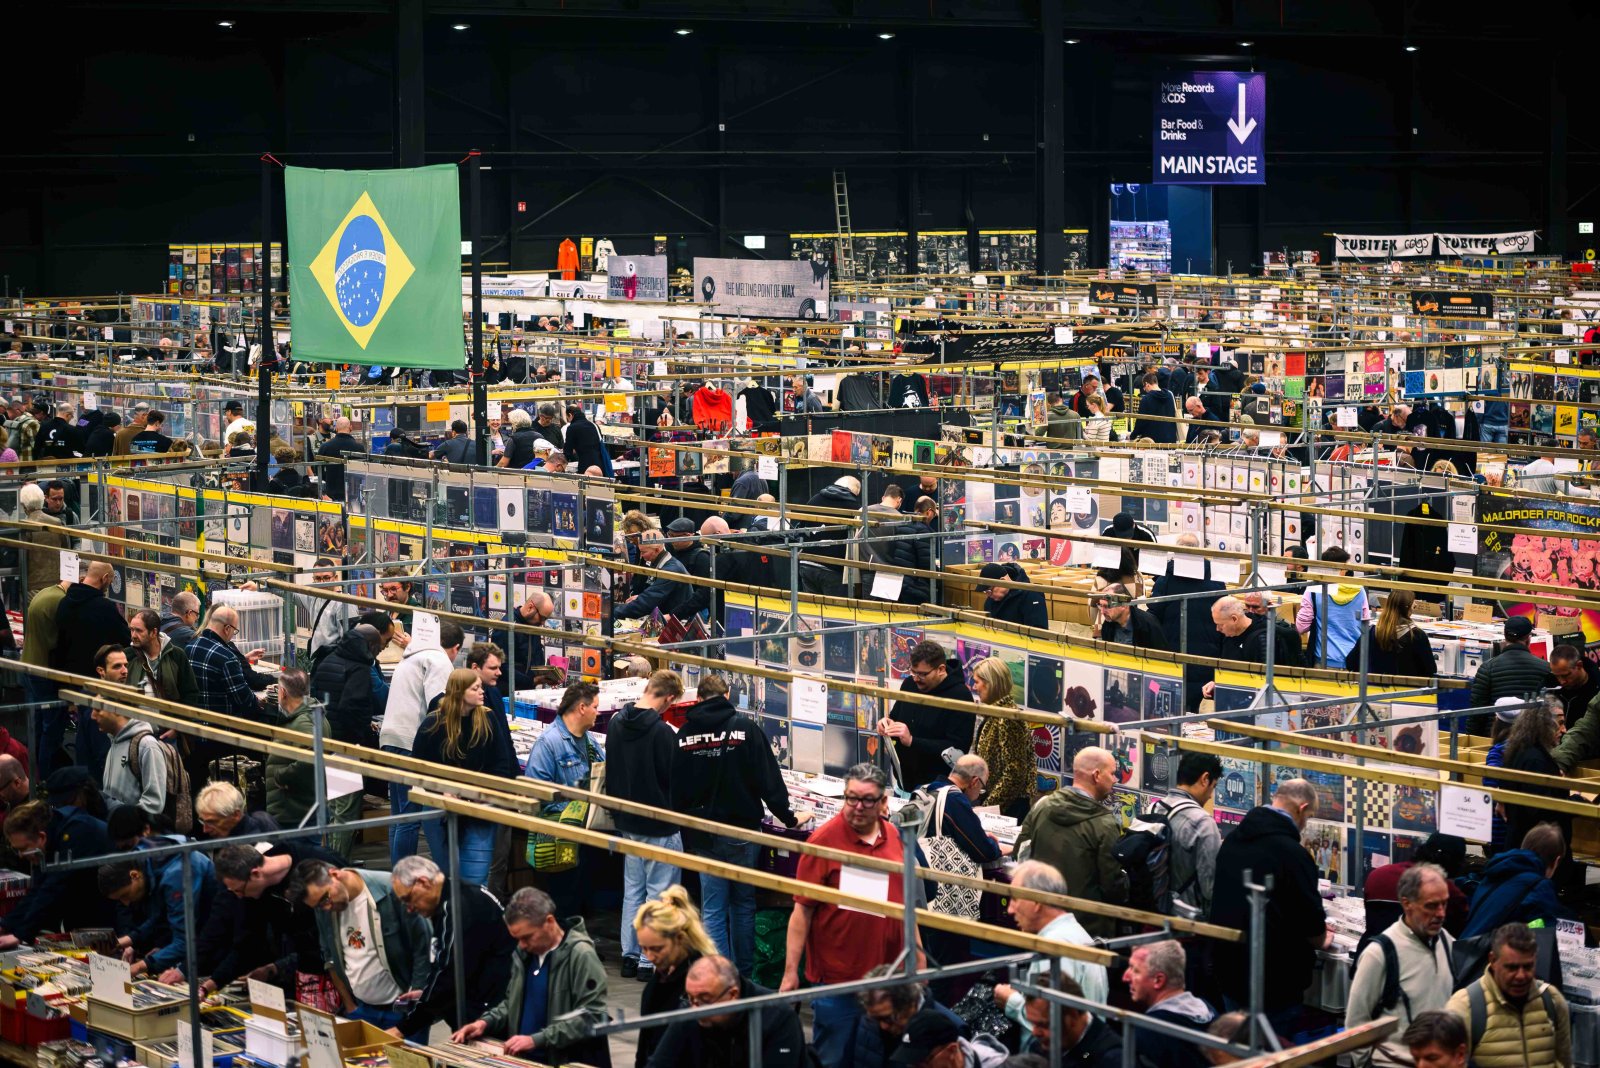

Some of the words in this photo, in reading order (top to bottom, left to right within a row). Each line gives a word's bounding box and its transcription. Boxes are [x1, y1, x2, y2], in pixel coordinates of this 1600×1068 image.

[1161, 82, 1182, 92] More
[1182, 82, 1215, 93] Records
[1161, 93, 1186, 103] &CDS
[1176, 119, 1197, 130] Food
[1197, 119, 1204, 130] &
[1161, 131, 1187, 140] Drinks
[1161, 156, 1204, 174] MAIN
[1206, 156, 1258, 174] STAGE
[1341, 239, 1398, 251] TUBITEK
[1443, 237, 1499, 250] TUBITEK
[725, 282, 735, 295] THE
[736, 283, 757, 297] MELTING
[758, 284, 773, 298] POINT
[774, 284, 781, 297] OF
[781, 285, 796, 298] WAX
[1148, 345, 1162, 353] BACK
[1164, 345, 1180, 353] MUSIC
[1482, 509, 1544, 523] MAILORDER
[1546, 510, 1566, 522] FOR
